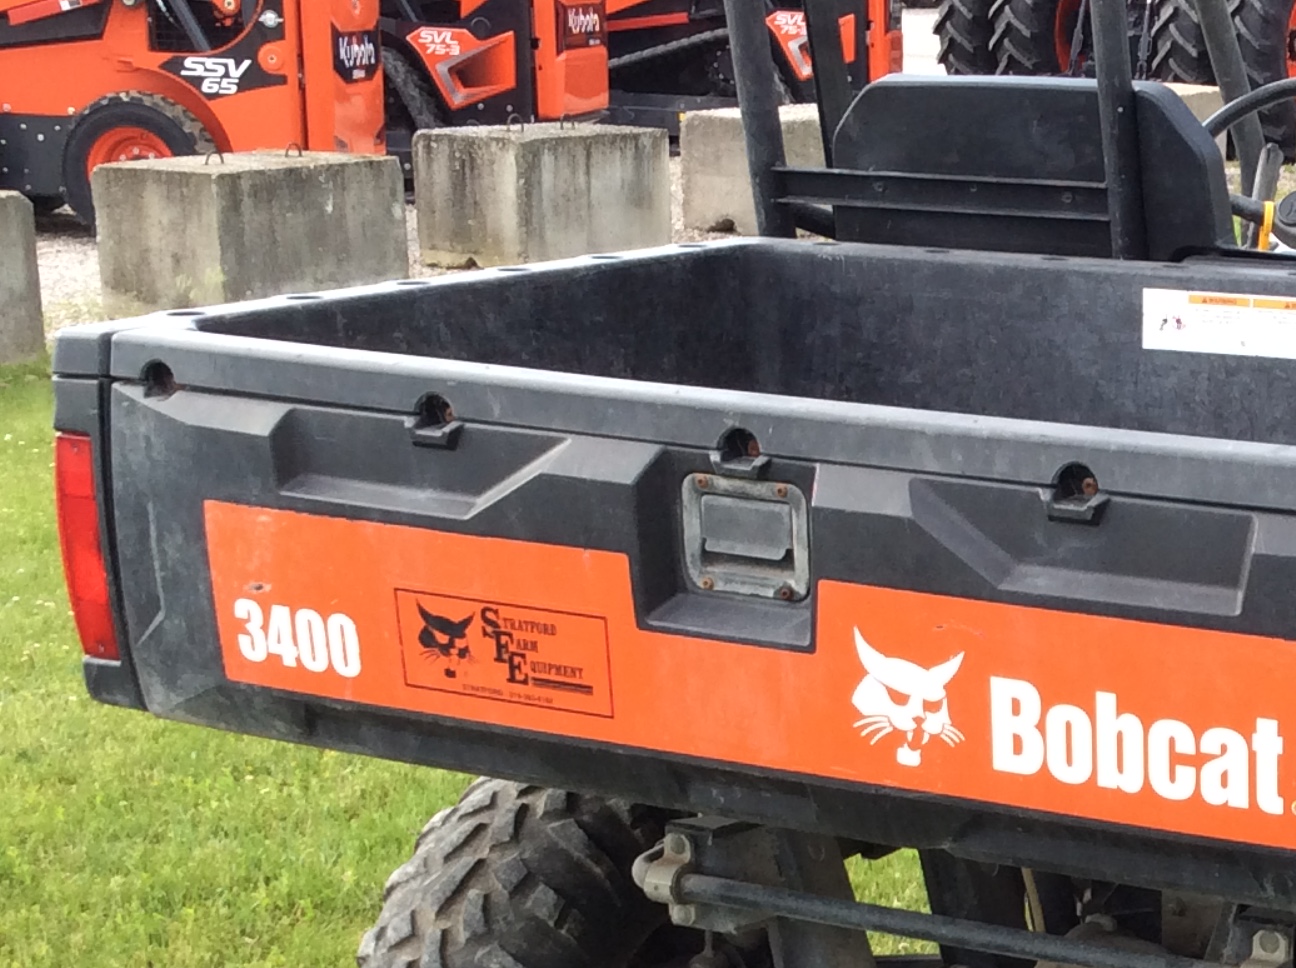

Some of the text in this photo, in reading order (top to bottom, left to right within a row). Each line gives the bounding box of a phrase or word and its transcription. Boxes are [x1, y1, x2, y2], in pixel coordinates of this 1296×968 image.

[567, 6, 600, 34] Kubota
[774, 13, 806, 26] SVL
[338, 34, 376, 68] Kubota
[417, 30, 459, 45] SVL
[425, 44, 460, 56] 75-3
[180, 56, 252, 78] SSV
[200, 77, 240, 94] 65
[480, 606, 557, 639] STRATFORD
[234, 598, 362, 678] 3400
[492, 629, 538, 664] FARM
[506, 651, 583, 685] EQUIPMENT
[989, 675, 1285, 816] Bobcat
